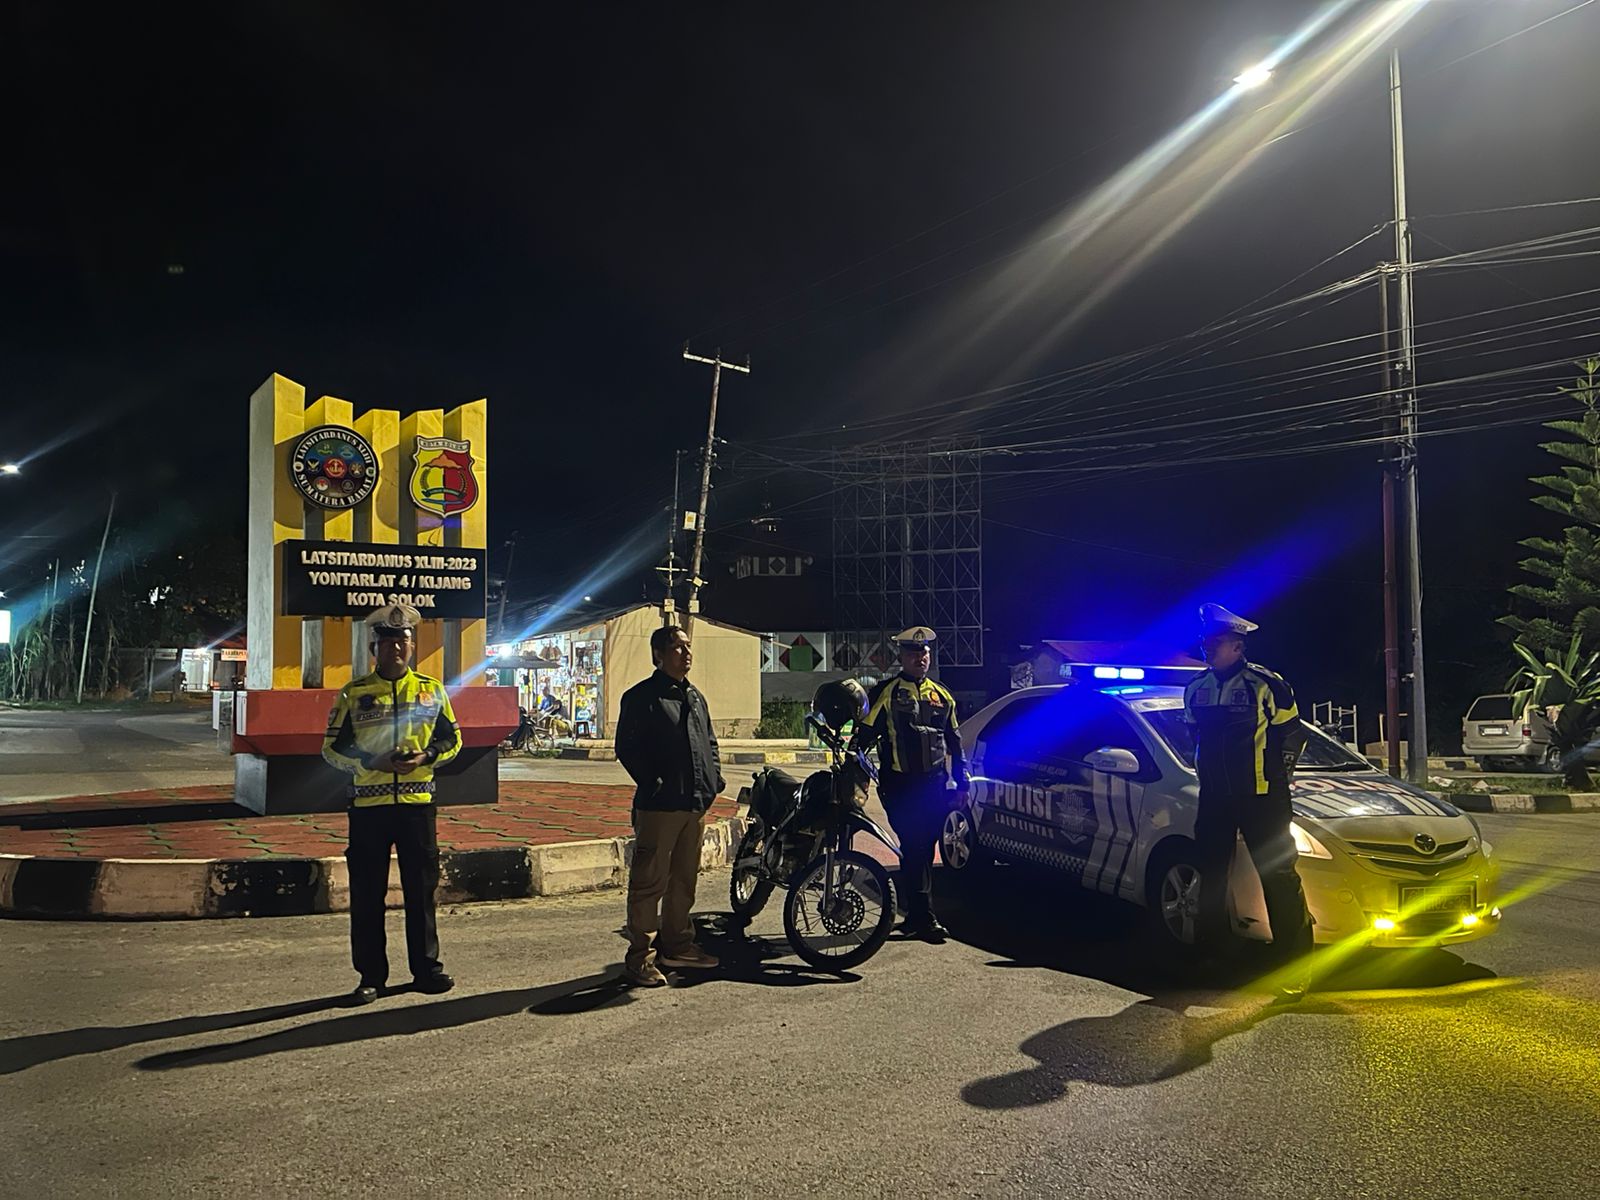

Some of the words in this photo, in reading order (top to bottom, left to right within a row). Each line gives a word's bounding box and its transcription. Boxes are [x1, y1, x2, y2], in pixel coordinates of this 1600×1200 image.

[297, 431, 357, 460] LATSITARDANUS
[357, 443, 372, 464] XLIII
[298, 473, 345, 506] SUMATERA
[347, 478, 372, 502] BARAT
[301, 550, 412, 569] LATSITARDANUS
[414, 555, 477, 571] XLIII-2023
[308, 571, 396, 588] YONTARLAT
[398, 574, 409, 588] 4
[411, 575, 417, 588] /
[419, 575, 472, 590] KIJANG
[347, 592, 386, 607] KOTA
[388, 593, 436, 608] SOLOK
[994, 780, 1052, 820] POLISI
[995, 812, 1017, 828] LALU
[1019, 819, 1054, 839] LINTAS
